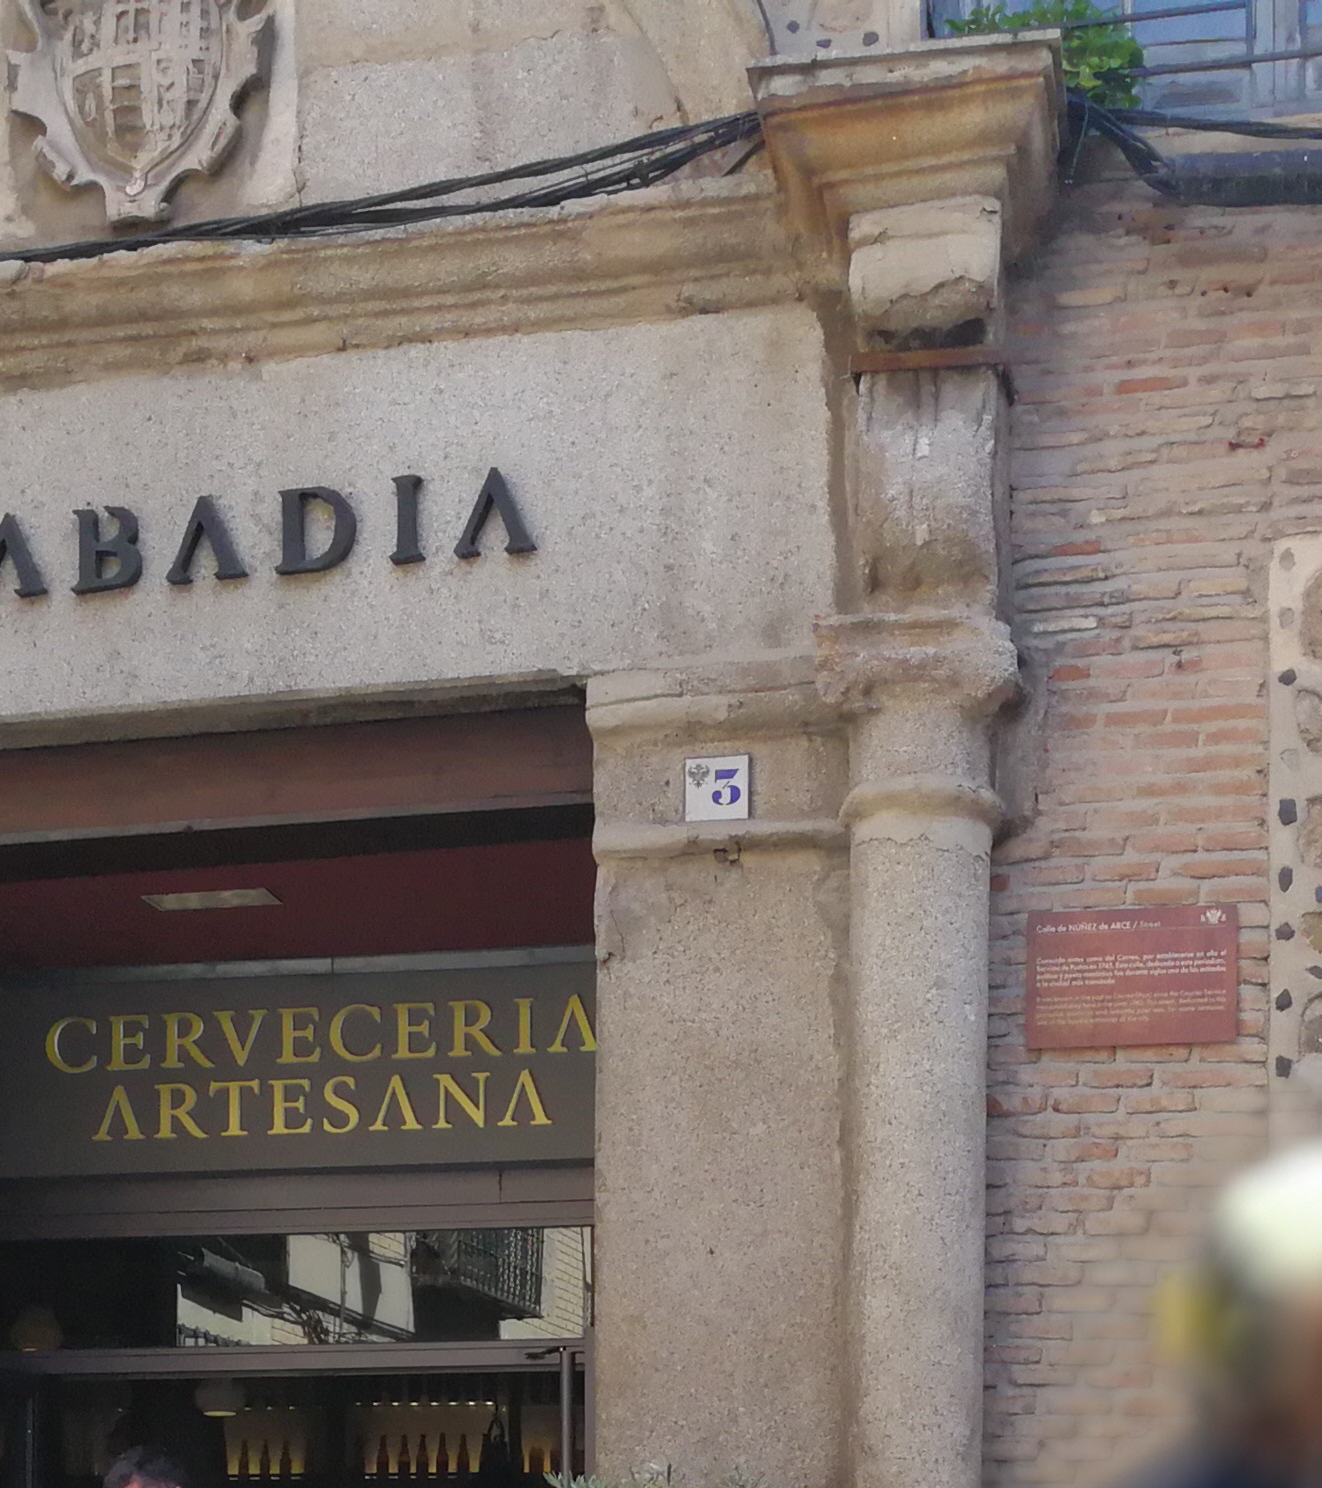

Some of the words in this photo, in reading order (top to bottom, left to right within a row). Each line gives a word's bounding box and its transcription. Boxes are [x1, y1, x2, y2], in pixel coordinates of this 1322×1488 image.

[711, 768, 741, 806] 3
[45, 994, 597, 1074] CERVECERIA
[92, 1068, 552, 1141] ARTESANA
